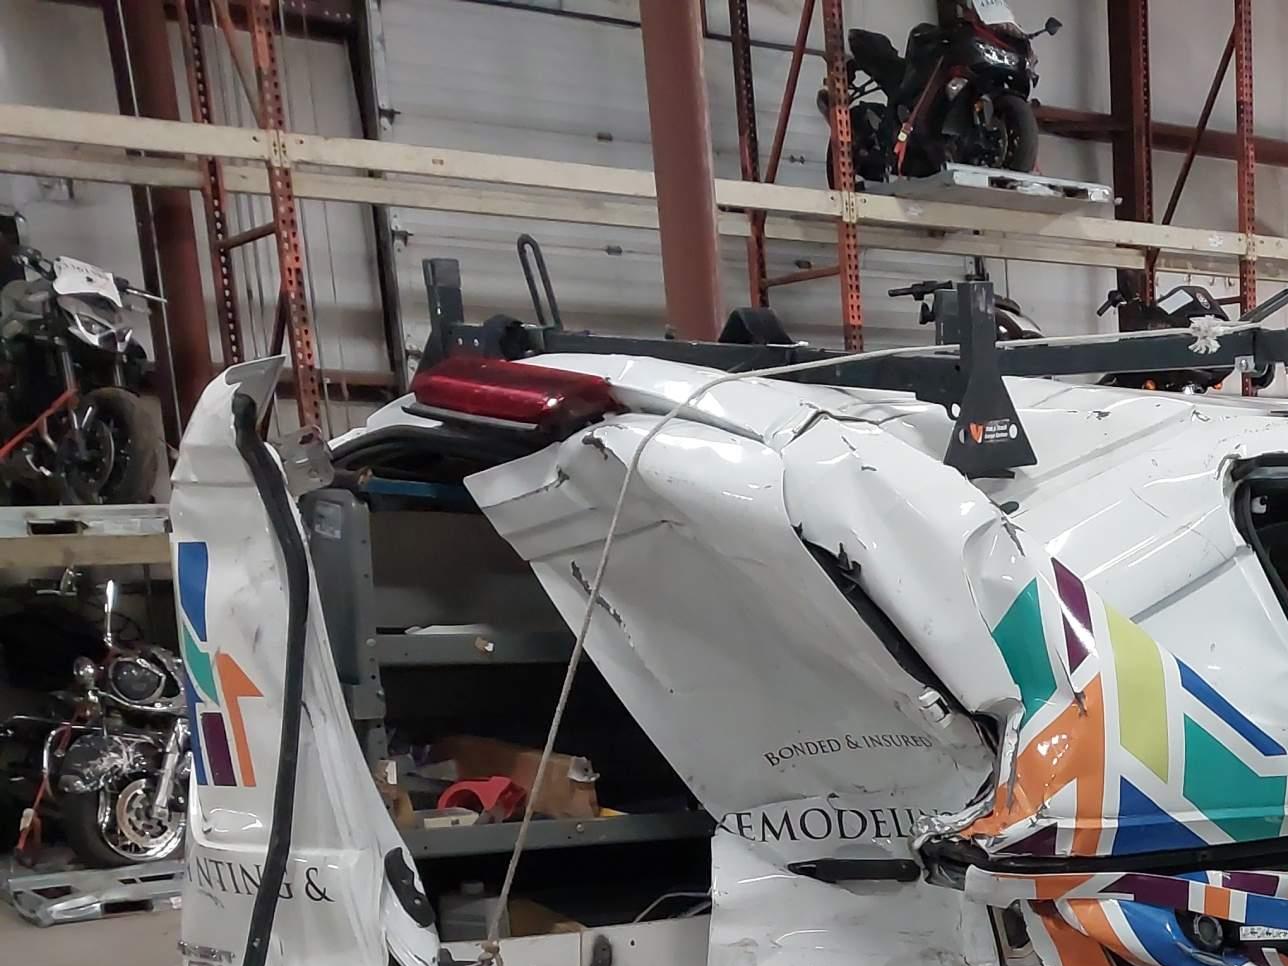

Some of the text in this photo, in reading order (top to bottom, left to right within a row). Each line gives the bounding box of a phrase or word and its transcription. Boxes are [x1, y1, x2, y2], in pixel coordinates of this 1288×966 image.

[764, 734, 933, 767] BONDED & INSURED
[305, 867, 336, 903] &
